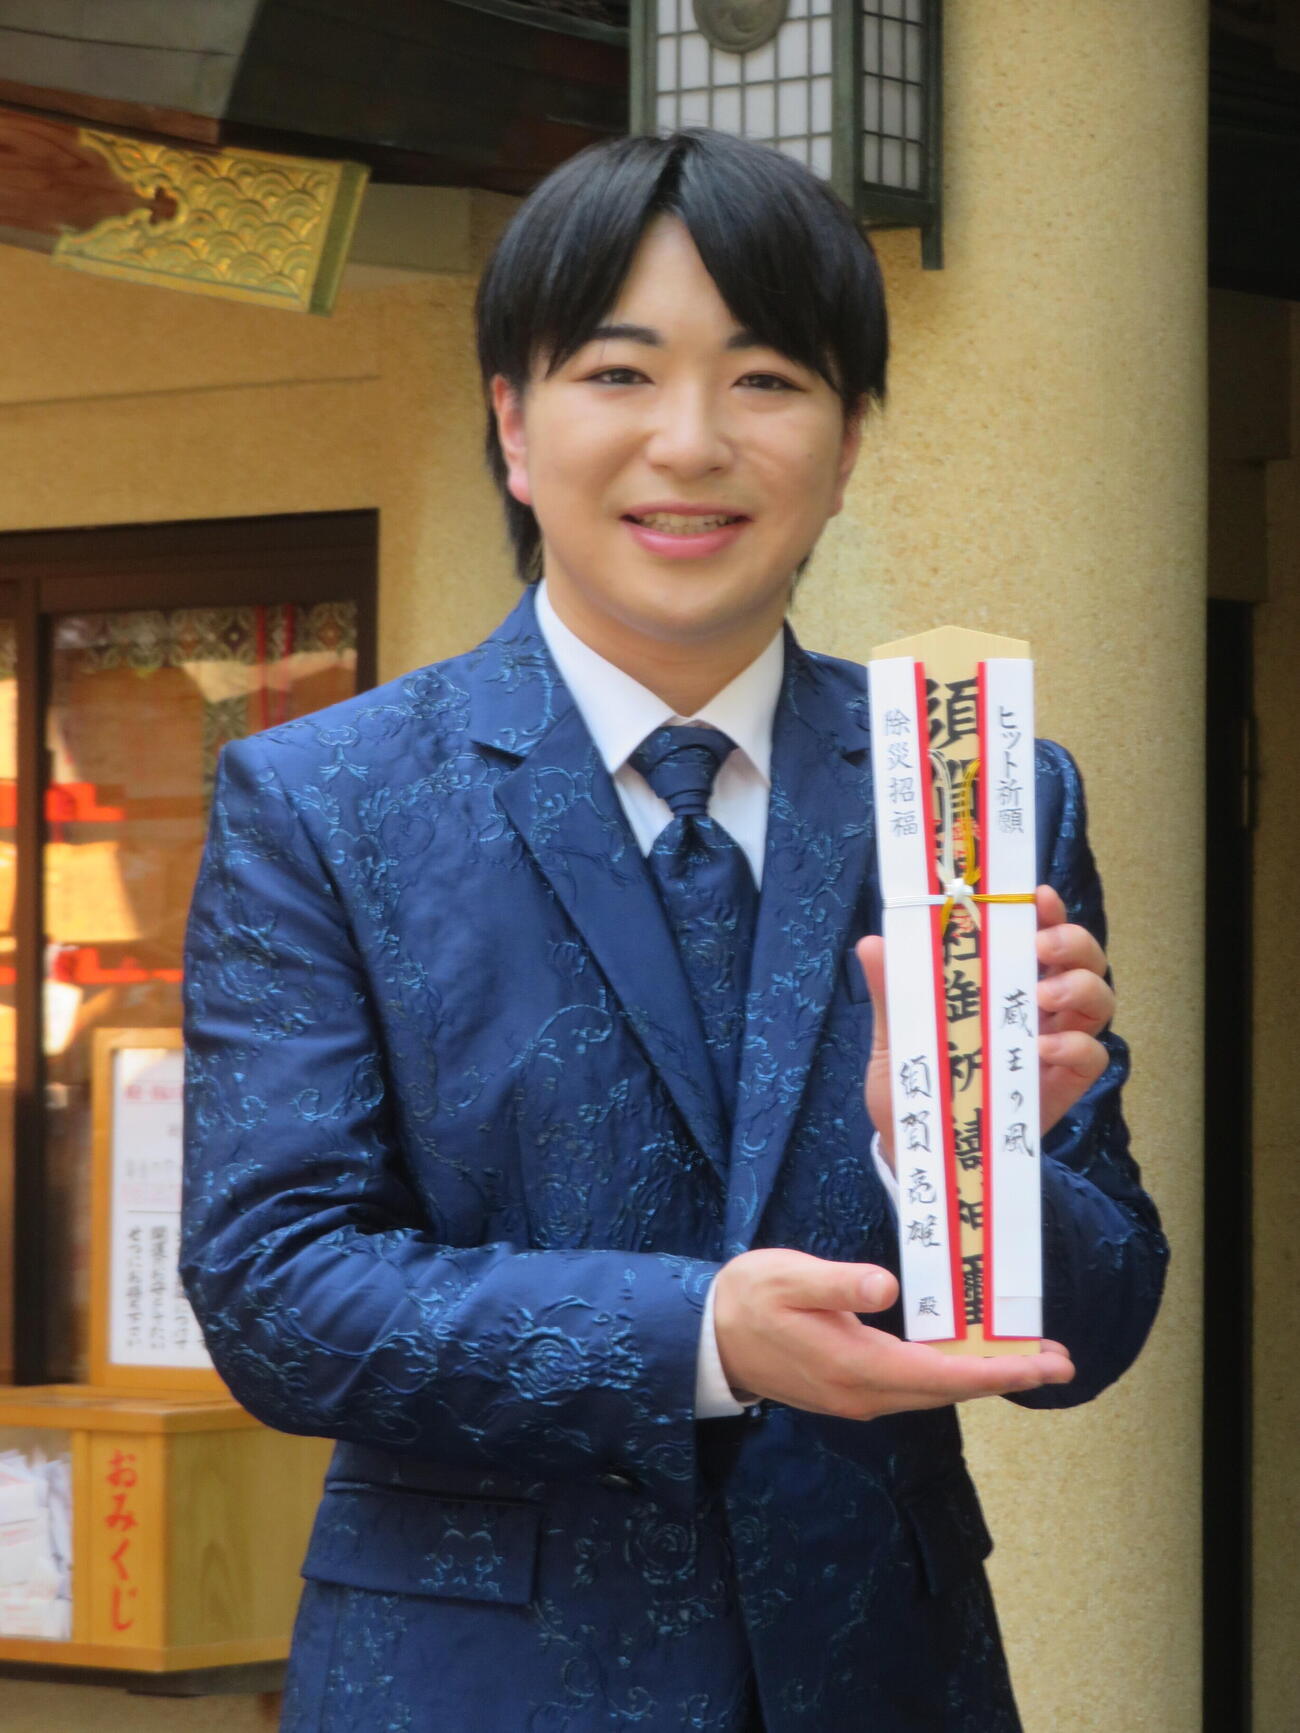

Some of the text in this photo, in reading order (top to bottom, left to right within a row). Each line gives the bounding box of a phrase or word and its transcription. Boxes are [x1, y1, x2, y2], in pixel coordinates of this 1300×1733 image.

[998, 705, 1025, 835] ヒット祈願
[1001, 989, 1036, 1158] 蔵王の風
[105, 1449, 138, 1631] おみくじ
